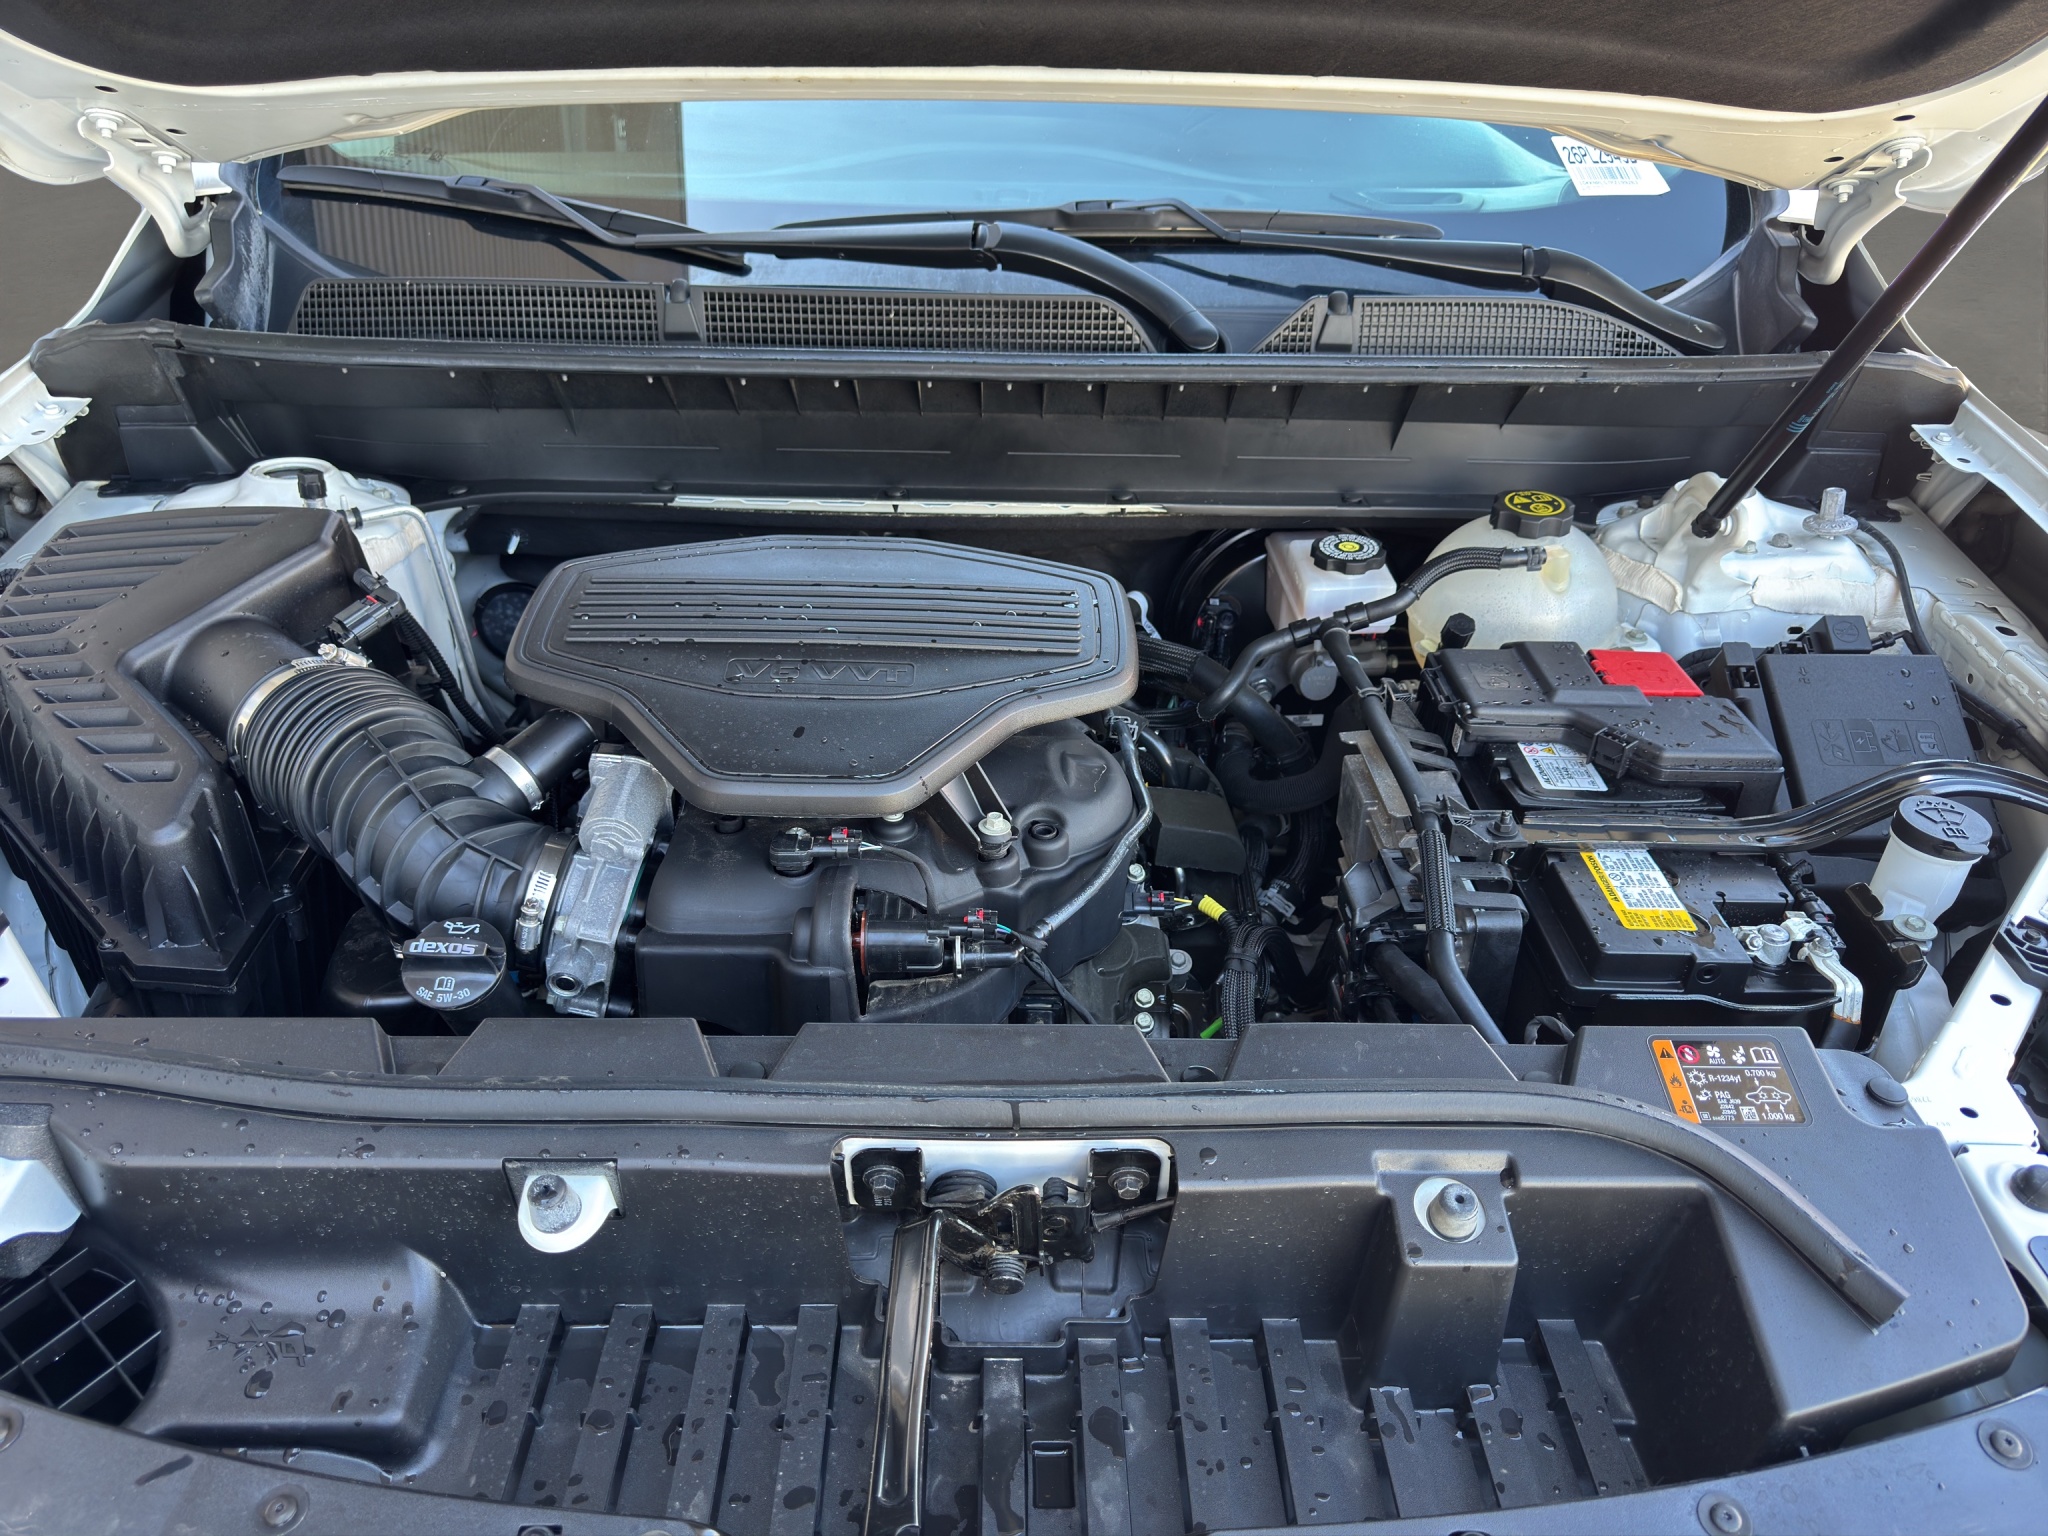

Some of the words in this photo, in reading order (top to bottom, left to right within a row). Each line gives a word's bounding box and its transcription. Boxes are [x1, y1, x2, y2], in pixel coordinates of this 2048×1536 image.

[1562, 146, 1638, 165] 26PL29
[735, 662, 800, 679] V6
[811, 664, 908, 682] VVT
[409, 938, 476, 955] dexos
[416, 986, 434, 1001] SAE
[436, 987, 471, 1003] 5W-30
[1708, 1074, 1742, 1084] R-1234yf
[1744, 1069, 1765, 1077] 0.700
[1766, 1070, 1777, 1078] kg
[1714, 1090, 1731, 1099] PAG
[1761, 1112, 1783, 1121] 1.000
[1784, 1112, 1795, 1122] kg
